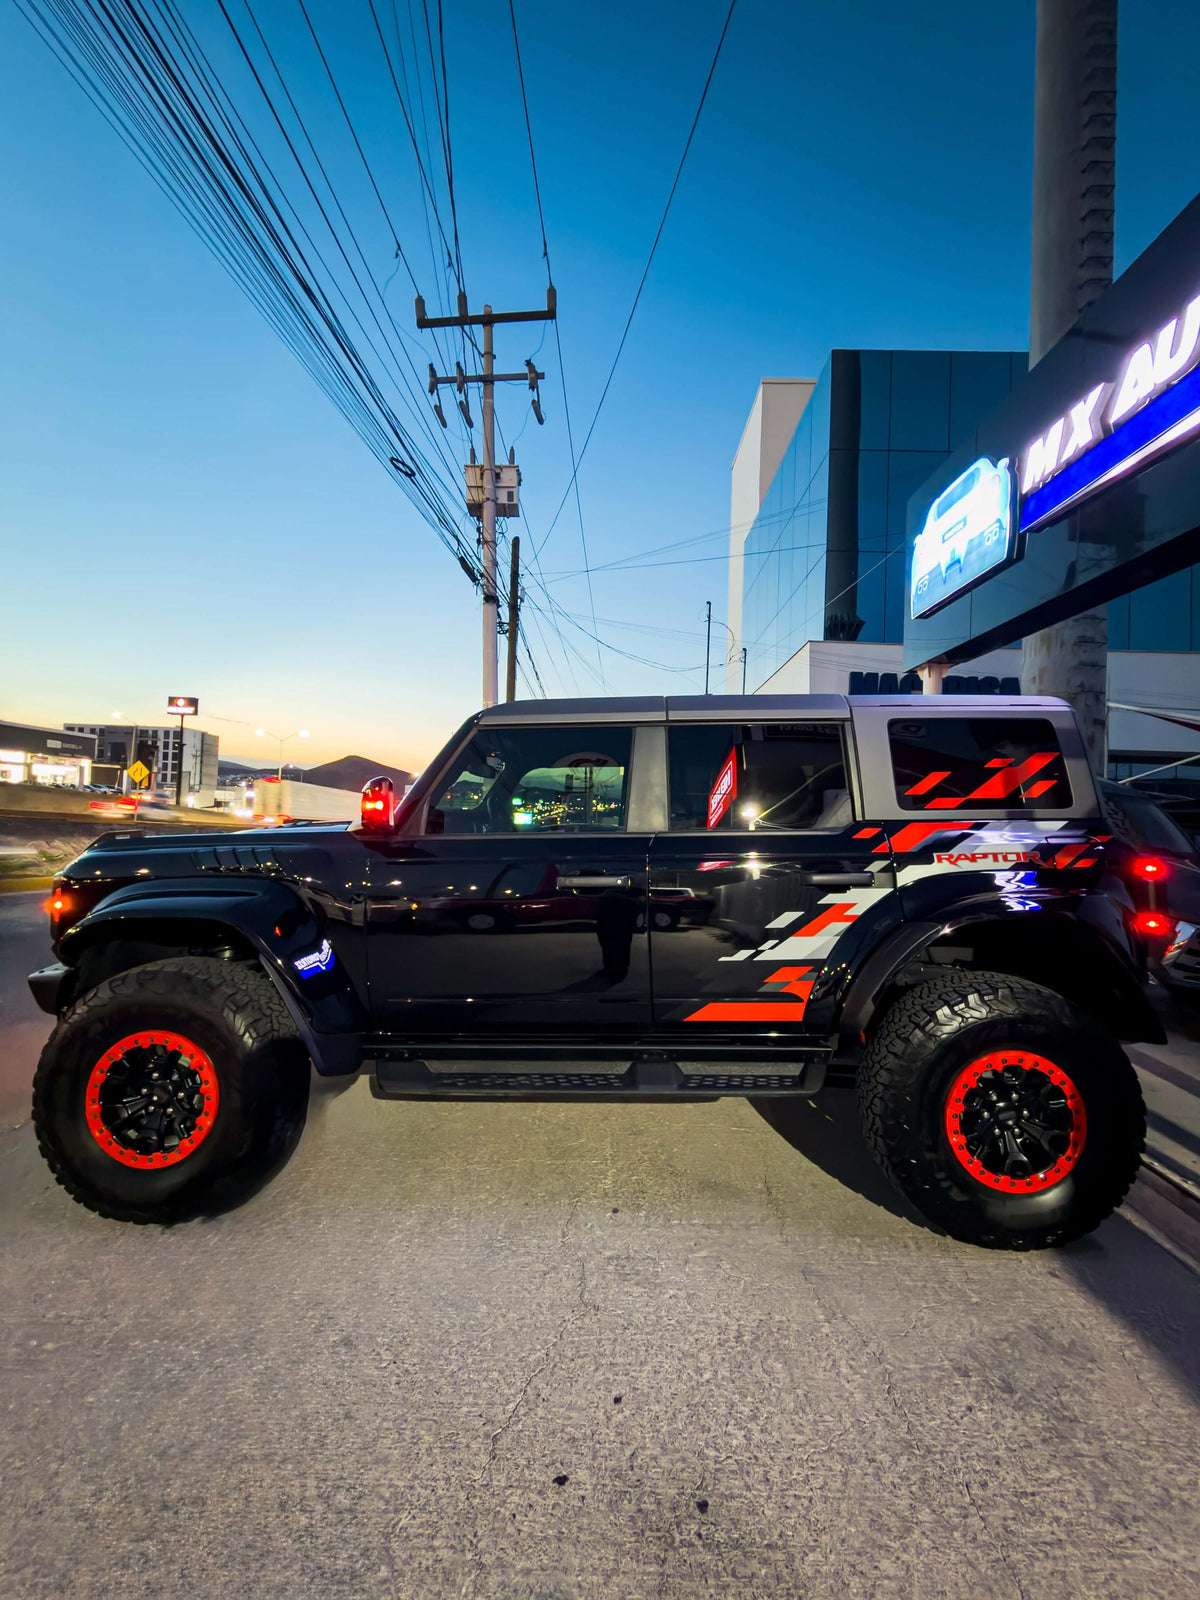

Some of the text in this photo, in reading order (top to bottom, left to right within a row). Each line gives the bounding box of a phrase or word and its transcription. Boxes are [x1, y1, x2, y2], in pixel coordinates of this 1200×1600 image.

[1021, 294, 1200, 494] MX AU
[934, 851, 1048, 869] RAPTOR
